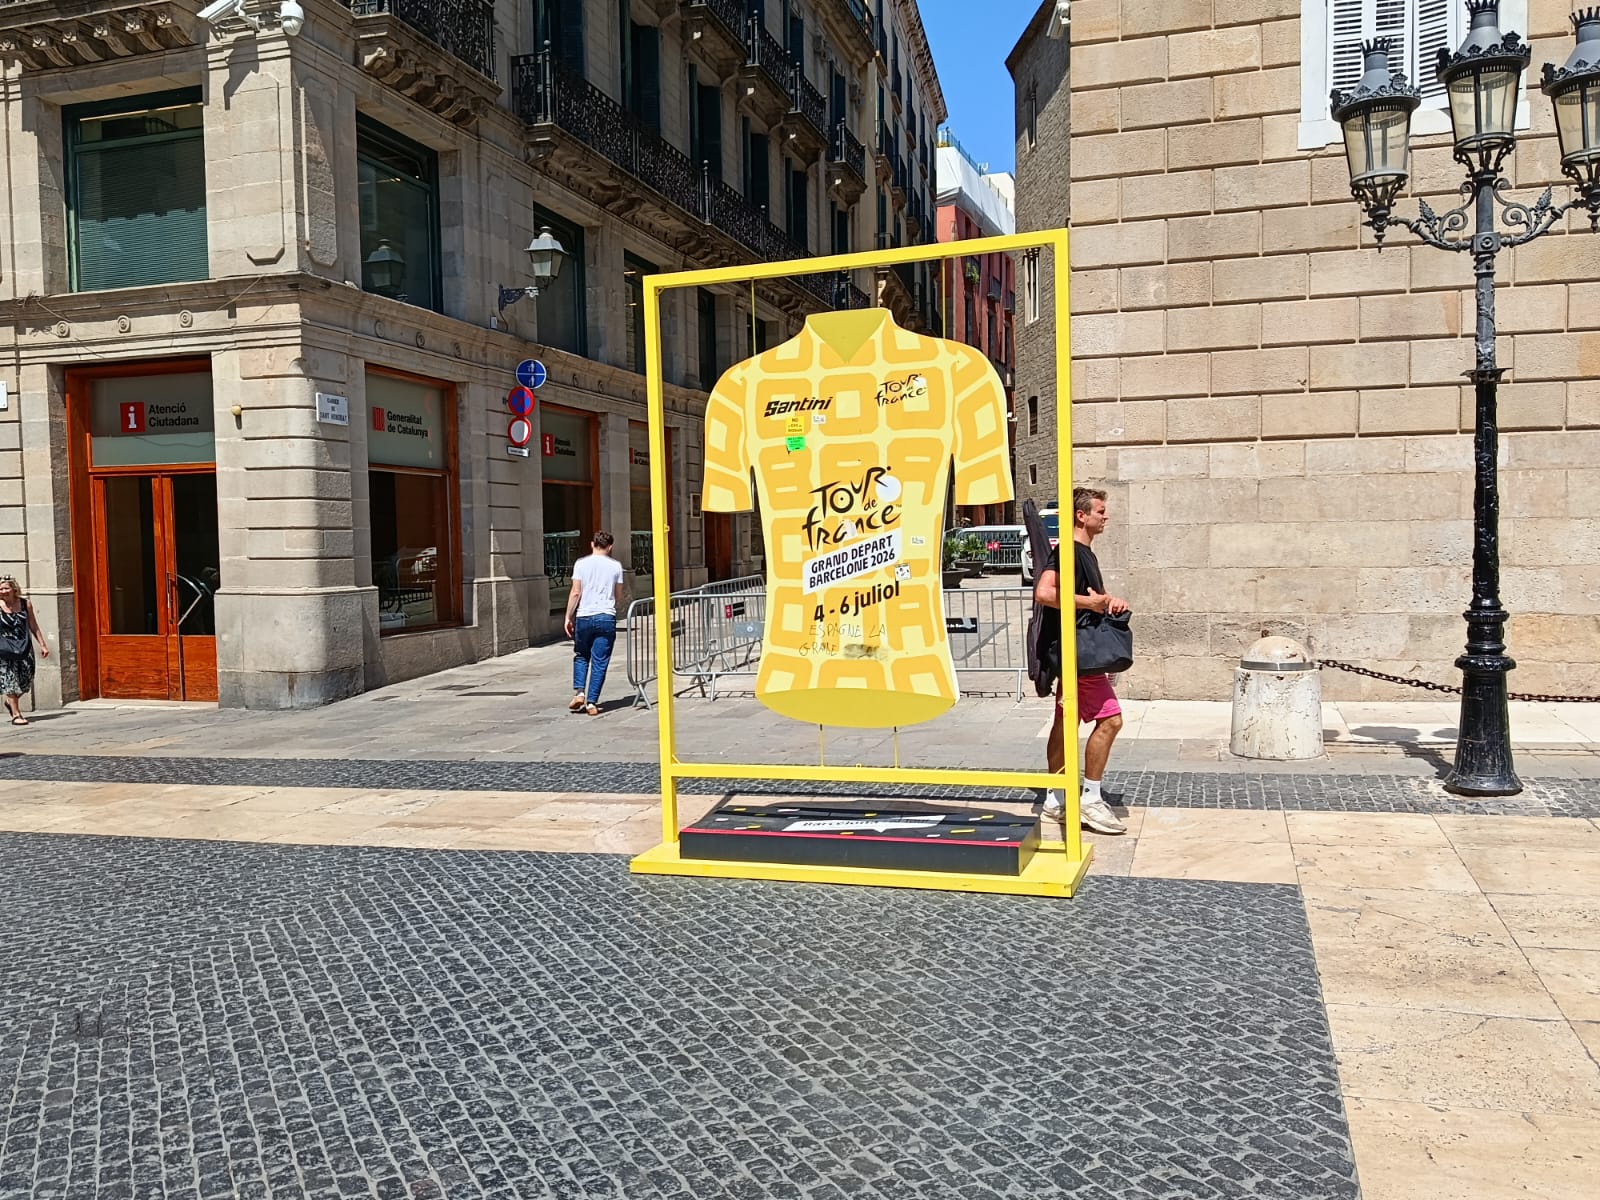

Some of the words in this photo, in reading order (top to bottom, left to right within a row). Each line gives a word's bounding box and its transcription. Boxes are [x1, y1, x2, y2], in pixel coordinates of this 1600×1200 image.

[148, 402, 186, 415] Atenció
[764, 396, 833, 417] Santini
[148, 415, 199, 428] Ciutadana
[387, 410, 422, 425] Generalitat
[387, 423, 396, 432] de
[397, 424, 429, 439] Catalunya
[863, 499, 878, 511] de
[811, 551, 848, 574] GRAND
[851, 534, 893, 560] DÉPART
[809, 557, 868, 588] BARCELONE
[871, 548, 895, 567] 2026
[814, 604, 825, 622] 4
[840, 595, 850, 614] 6
[853, 578, 900, 617] juliol
[809, 622, 862, 638] ESPAGNE
[869, 623, 886, 638] LA
